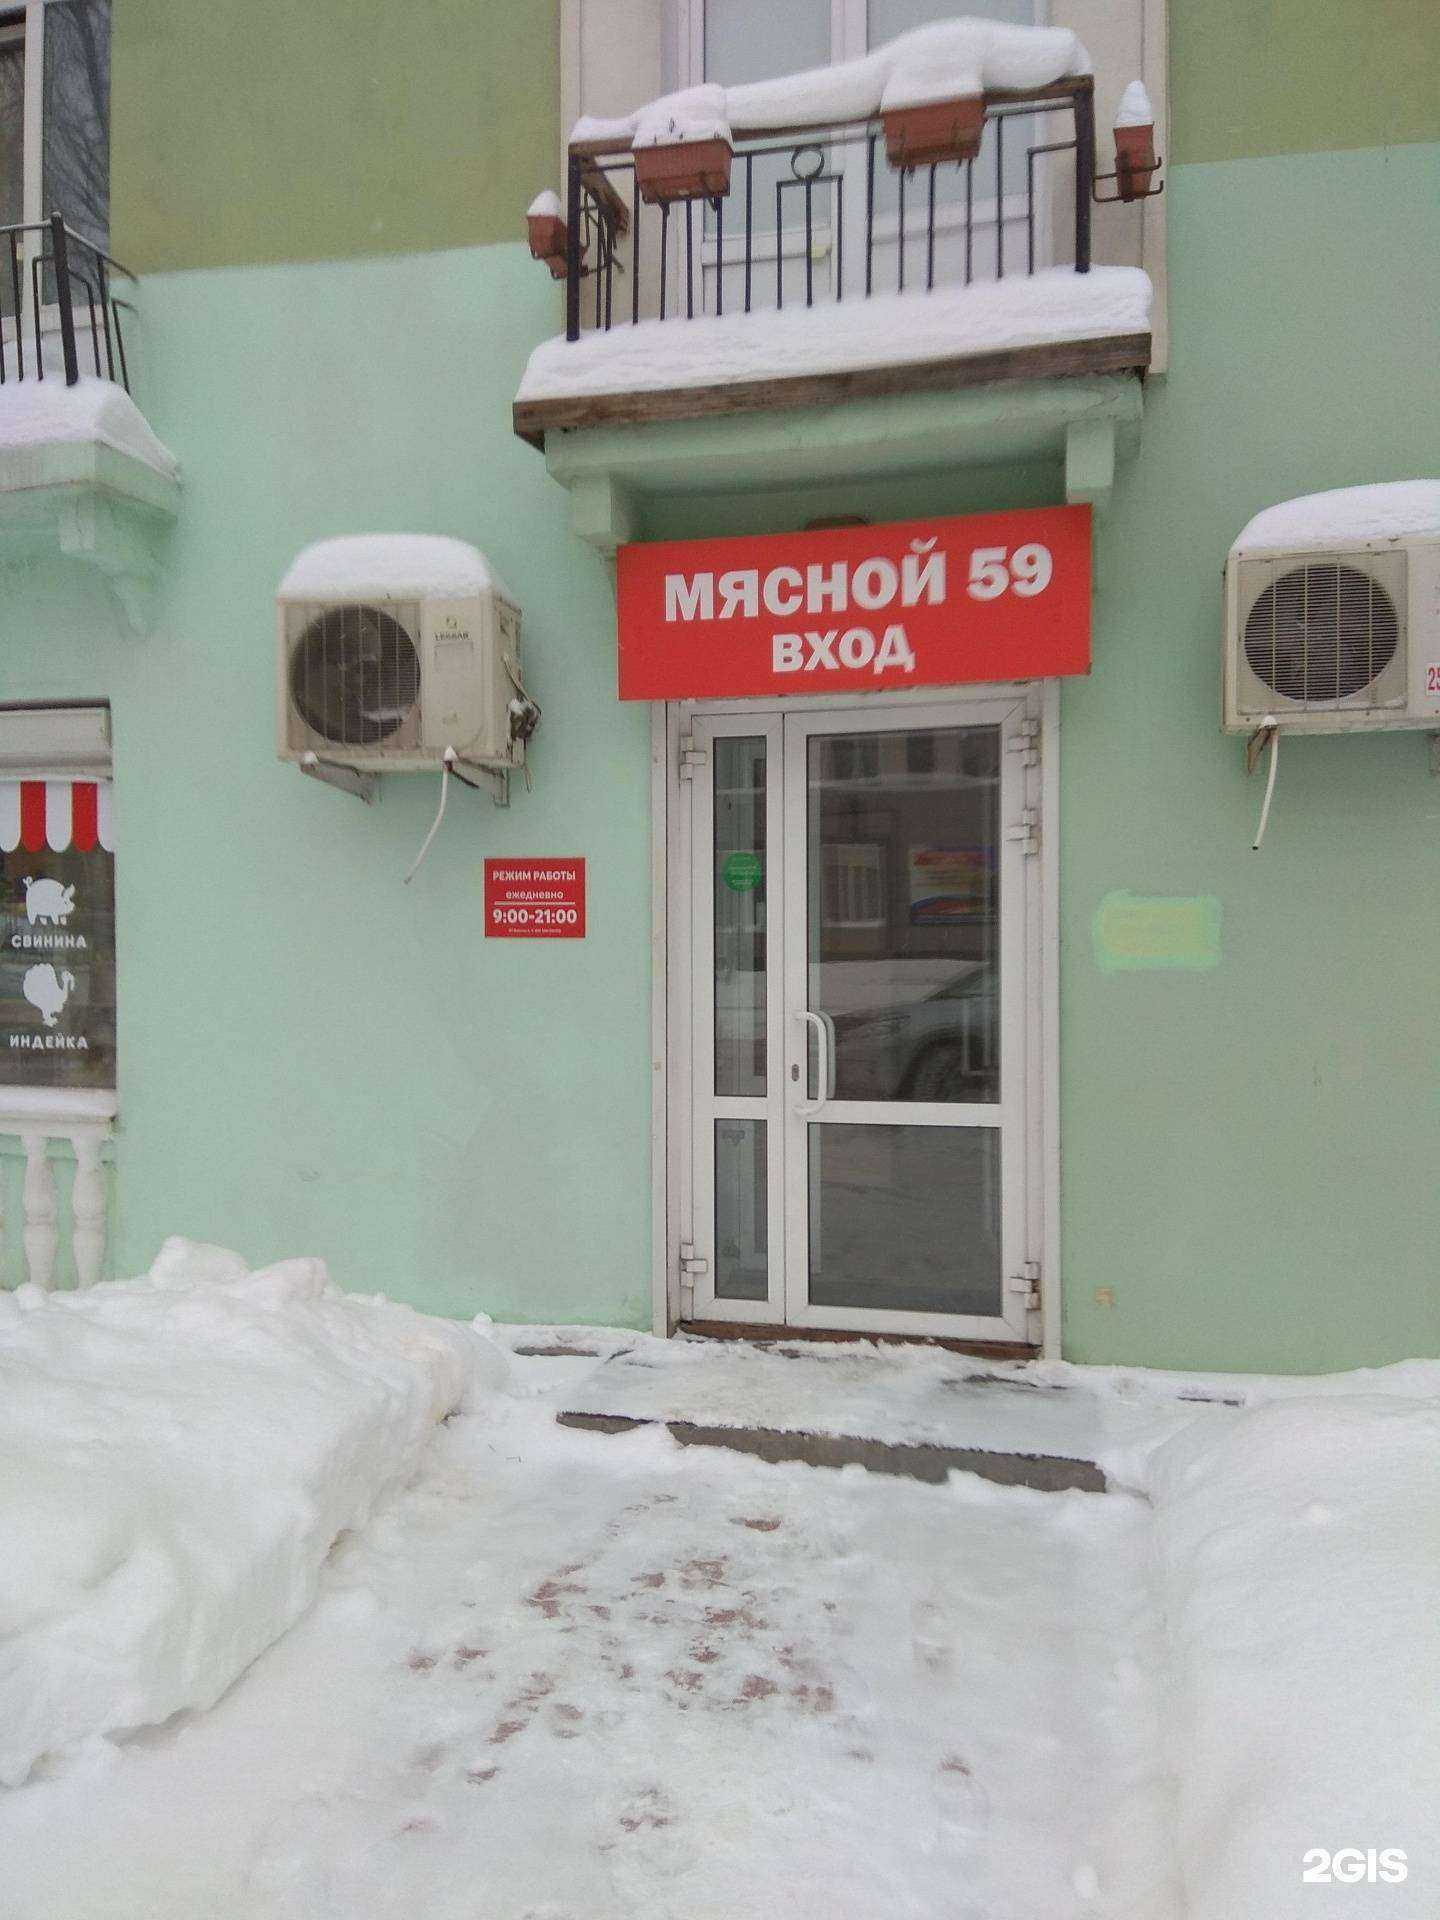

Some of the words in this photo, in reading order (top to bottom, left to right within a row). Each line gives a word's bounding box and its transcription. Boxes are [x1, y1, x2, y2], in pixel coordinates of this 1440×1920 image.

[665, 537, 947, 622] МЯСНОЙ
[966, 542, 1054, 601] 59
[772, 624, 916, 675] ВХОД
[492, 870, 531, 881] РЕЖИМ
[533, 869, 576, 881] РАБОТЫ
[505, 890, 564, 900] ежедневно
[492, 908, 578, 924] 9:00-21:00
[11, 934, 87, 949] СВИНИНА
[9, 1032, 89, 1050] ИНДЕЙКА
